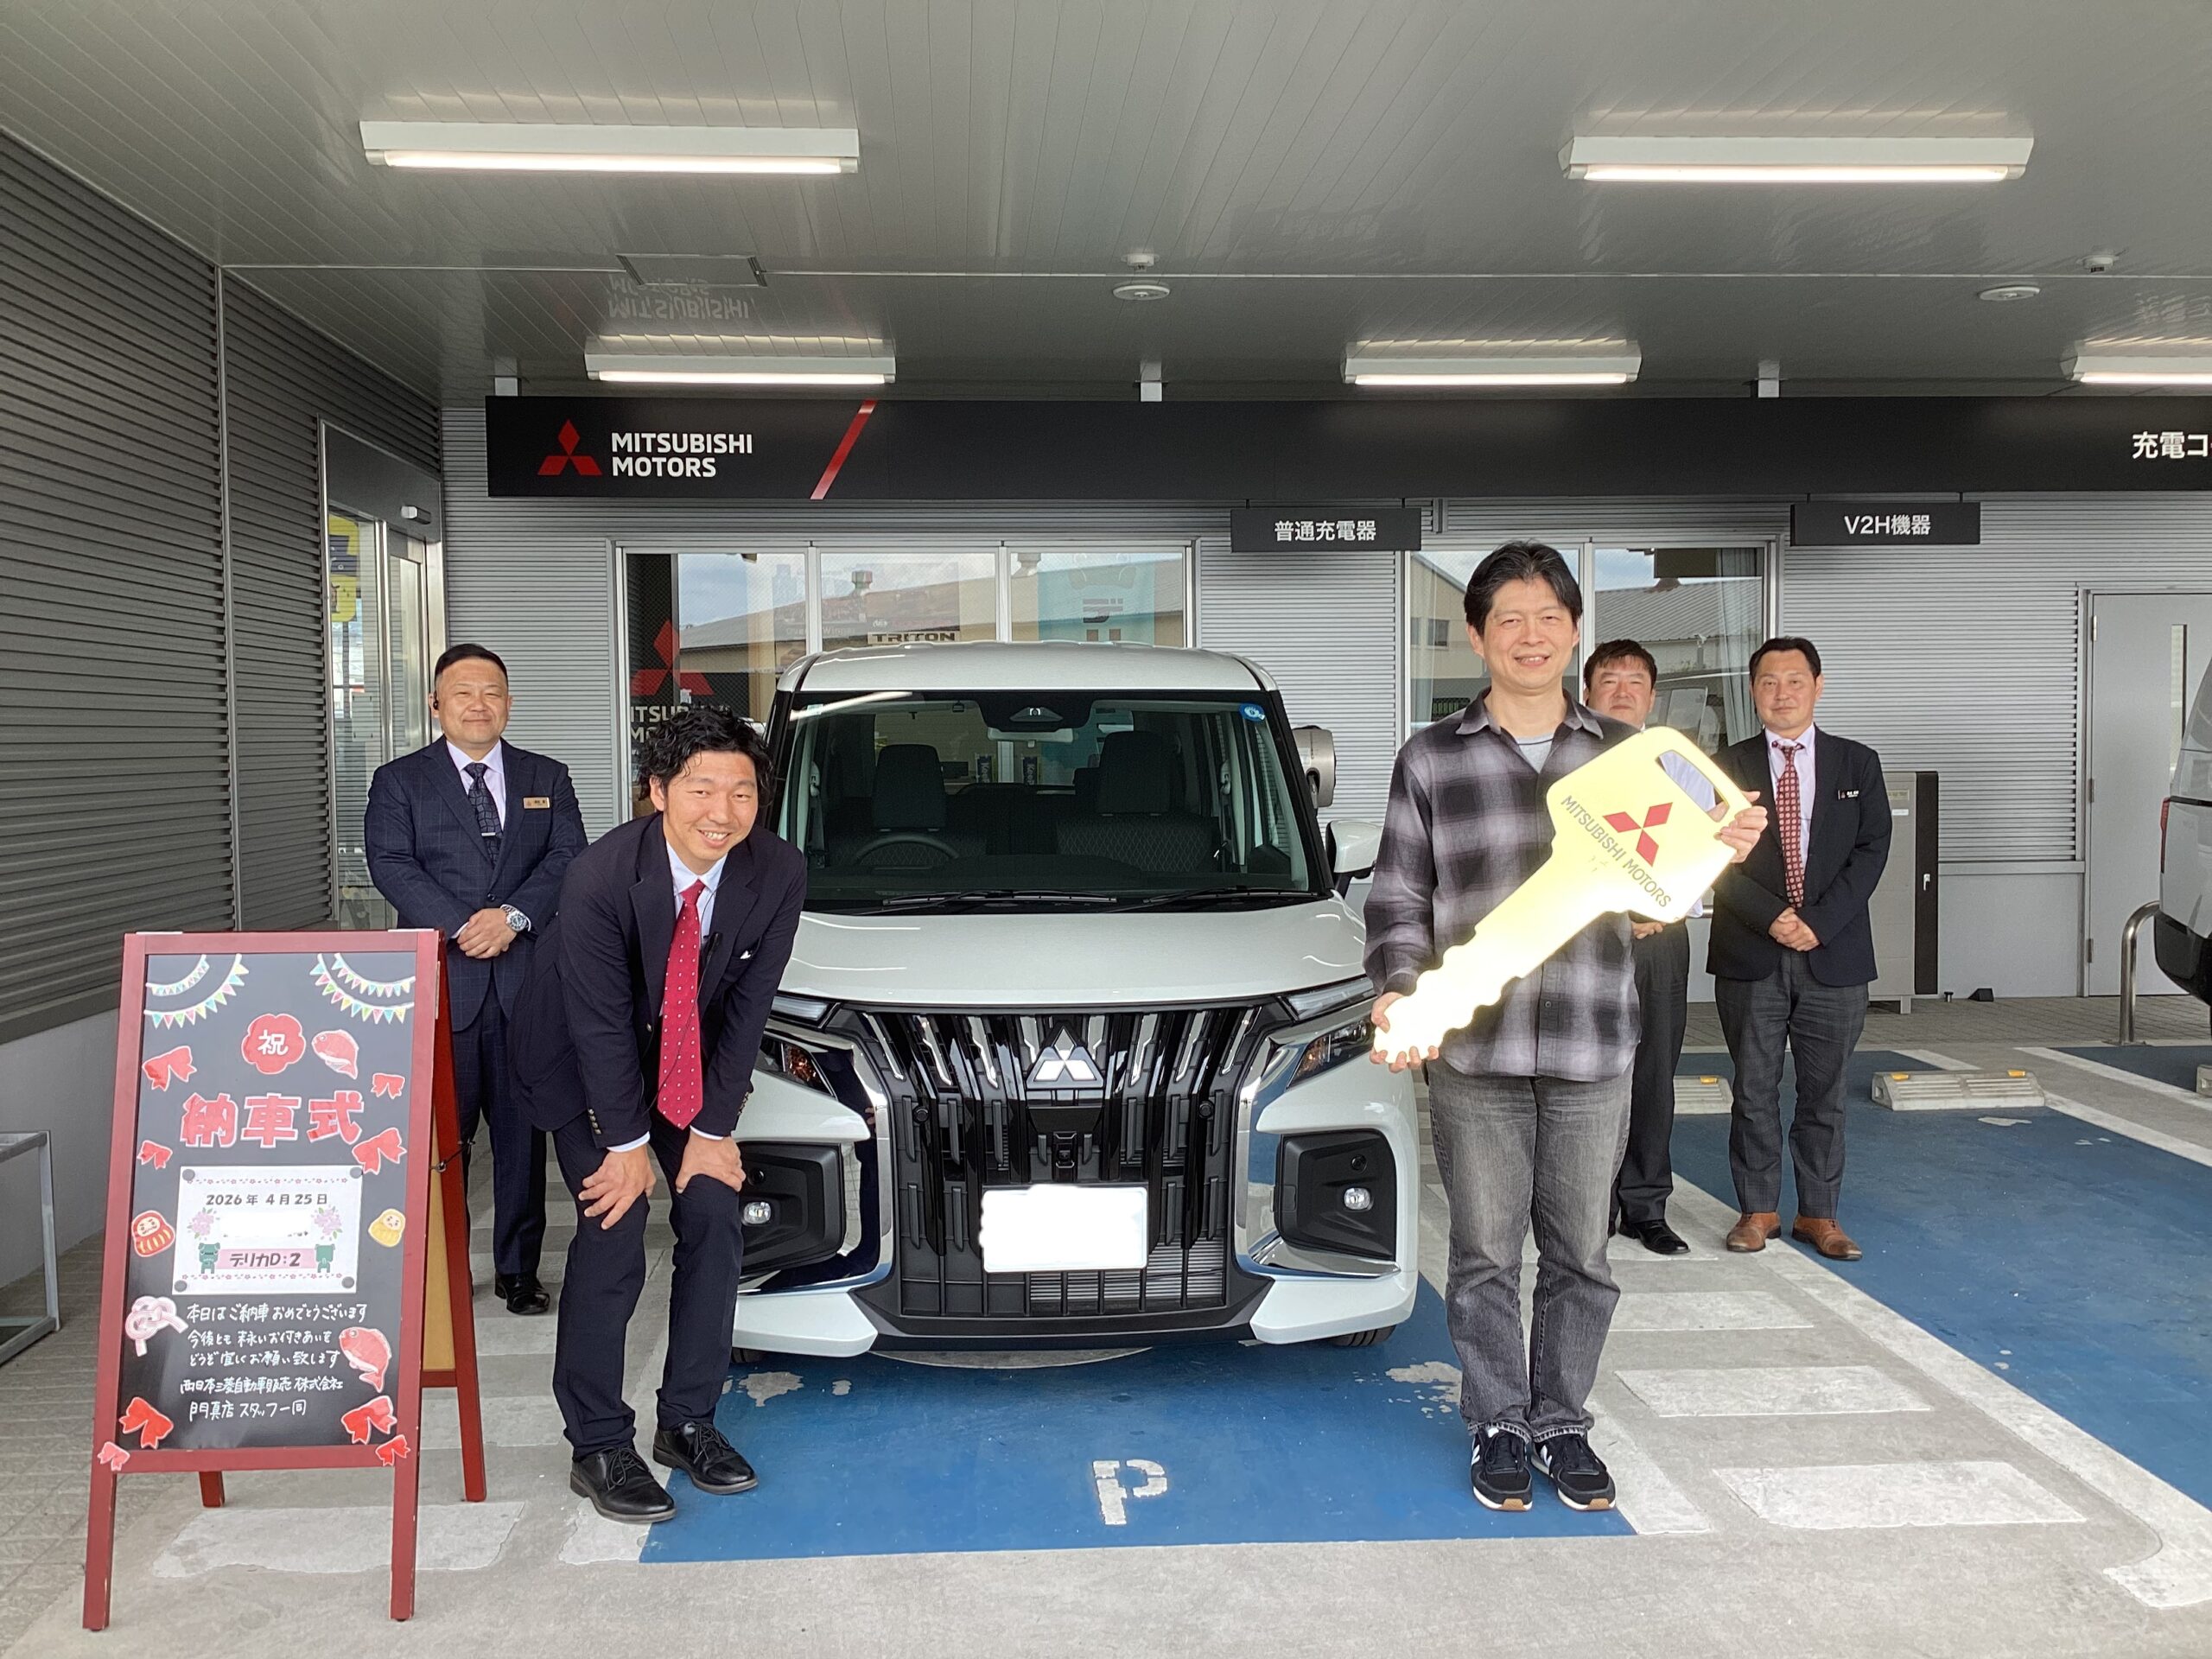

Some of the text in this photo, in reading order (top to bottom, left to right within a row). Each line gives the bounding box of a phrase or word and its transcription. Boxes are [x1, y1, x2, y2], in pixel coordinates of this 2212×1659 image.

[611, 433, 753, 454] MITSUBISHI
[2132, 431, 2212, 459] 充電コ
[612, 457, 716, 478] MOTORS
[1274, 520, 1377, 542] 普通充電器
[1844, 514, 1931, 536] V2H機器
[872, 632, 956, 643] TRITON
[1560, 794, 1672, 907] MITSUBISHI MOTORS
[257, 1029, 289, 1056] 祝
[180, 1090, 365, 1148] 納車式
[1093, 1459, 1167, 1525] P
